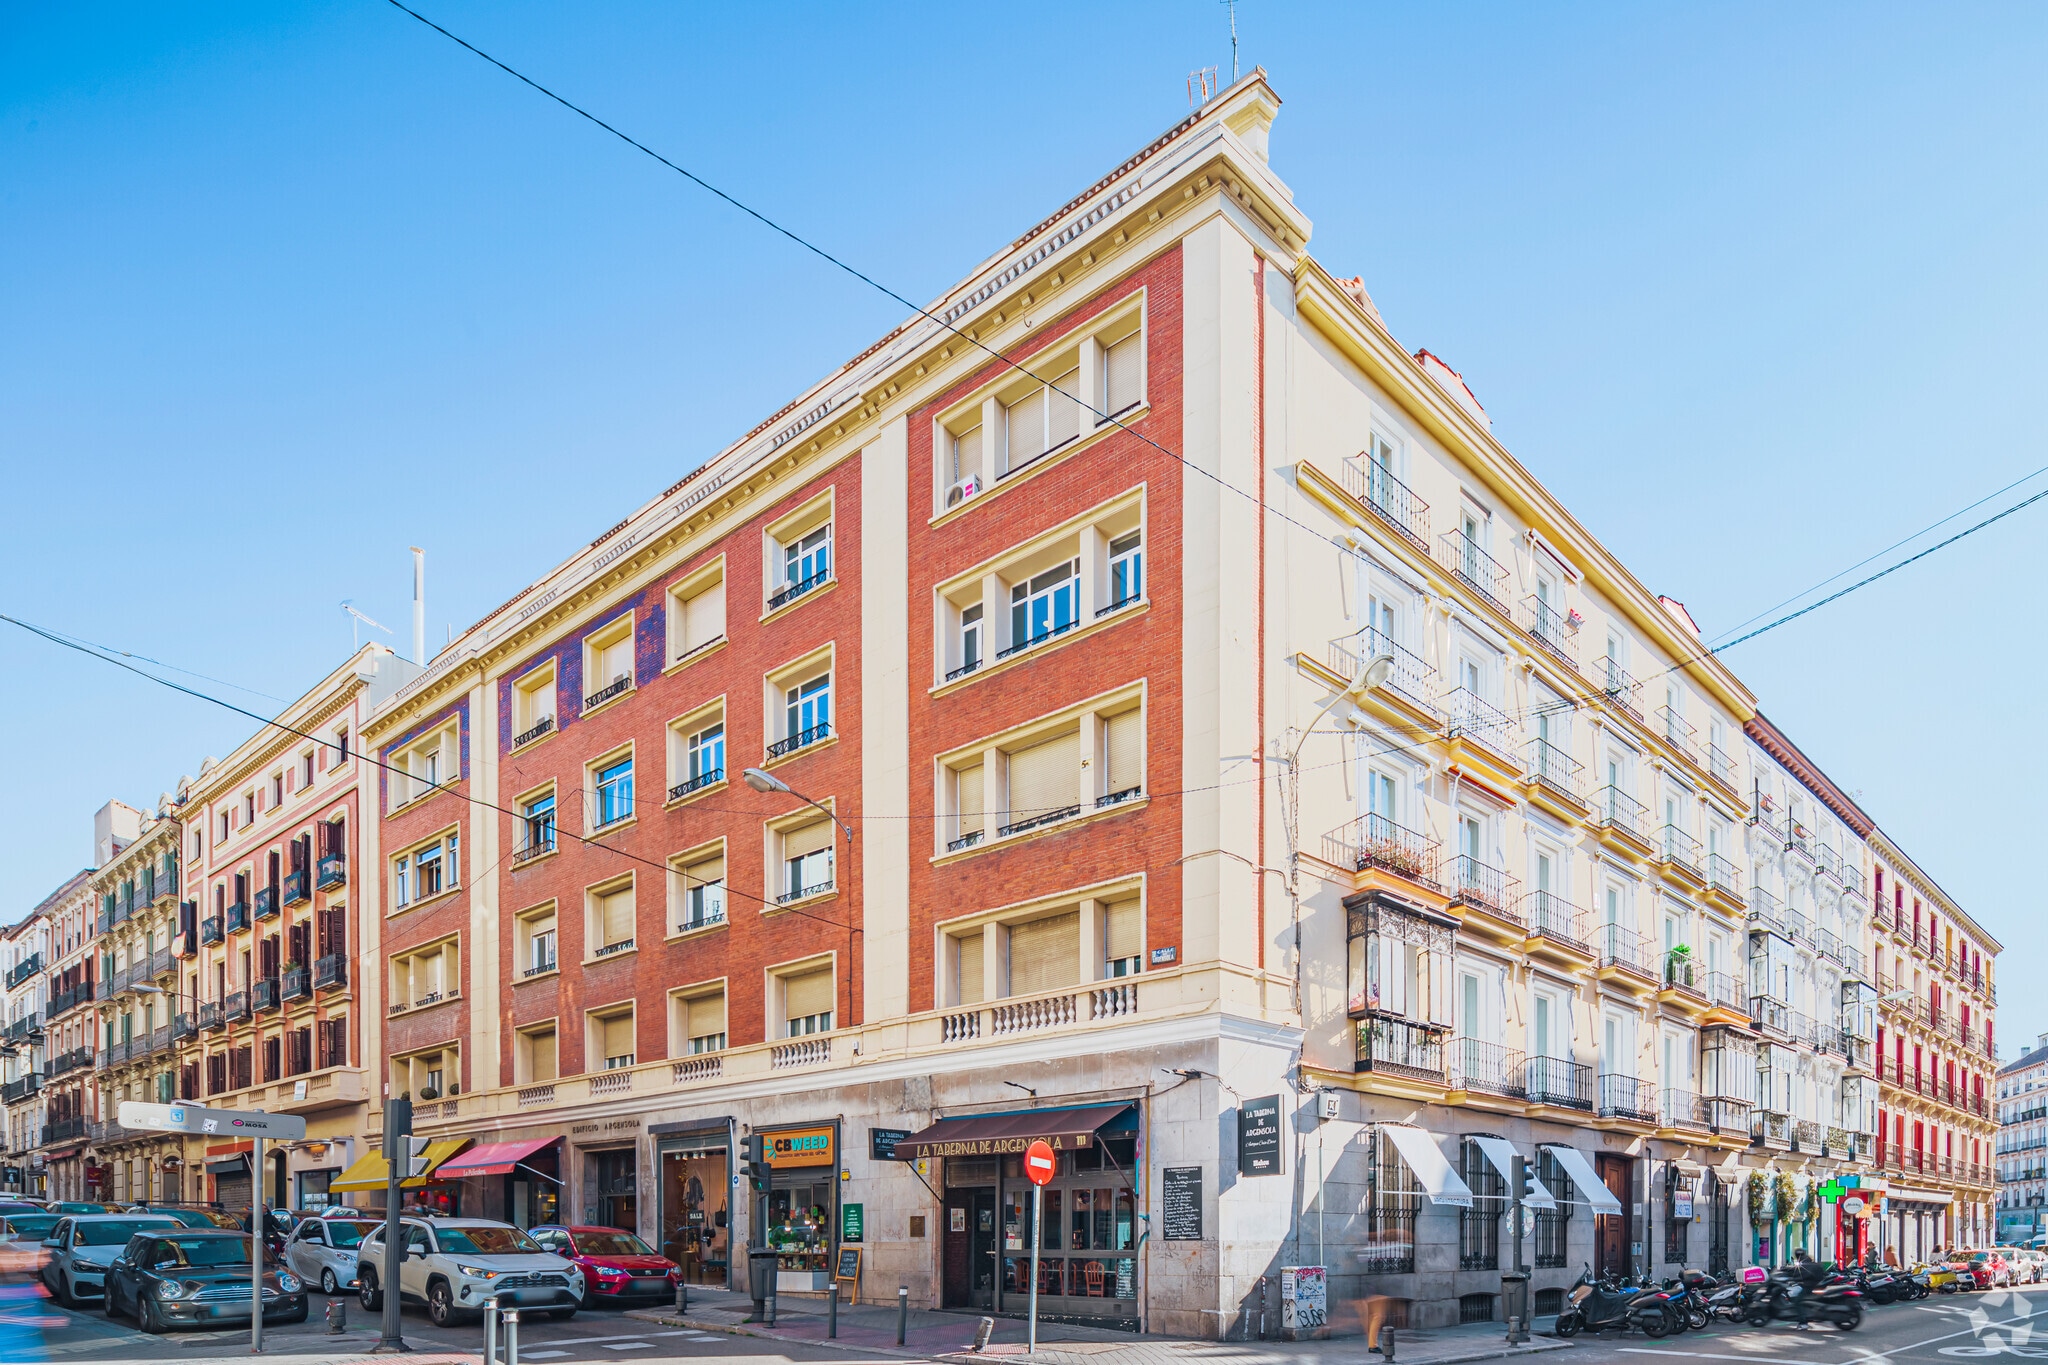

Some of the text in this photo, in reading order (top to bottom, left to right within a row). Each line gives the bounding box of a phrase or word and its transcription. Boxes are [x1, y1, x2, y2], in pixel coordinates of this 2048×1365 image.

[1254, 1108, 1275, 1117] TABERNA
[572, 1120, 641, 1134] EDIFICIO ARGENSOLA
[1258, 1118, 1264, 1126] DE
[1246, 1126, 1276, 1136] ARGENSOLA
[775, 1135, 828, 1152] CBWEED
[917, 1144, 930, 1158] LA
[932, 1141, 977, 1156] TABERNA
[979, 1140, 992, 1154] DE
[689, 1212, 703, 1220] SALE
